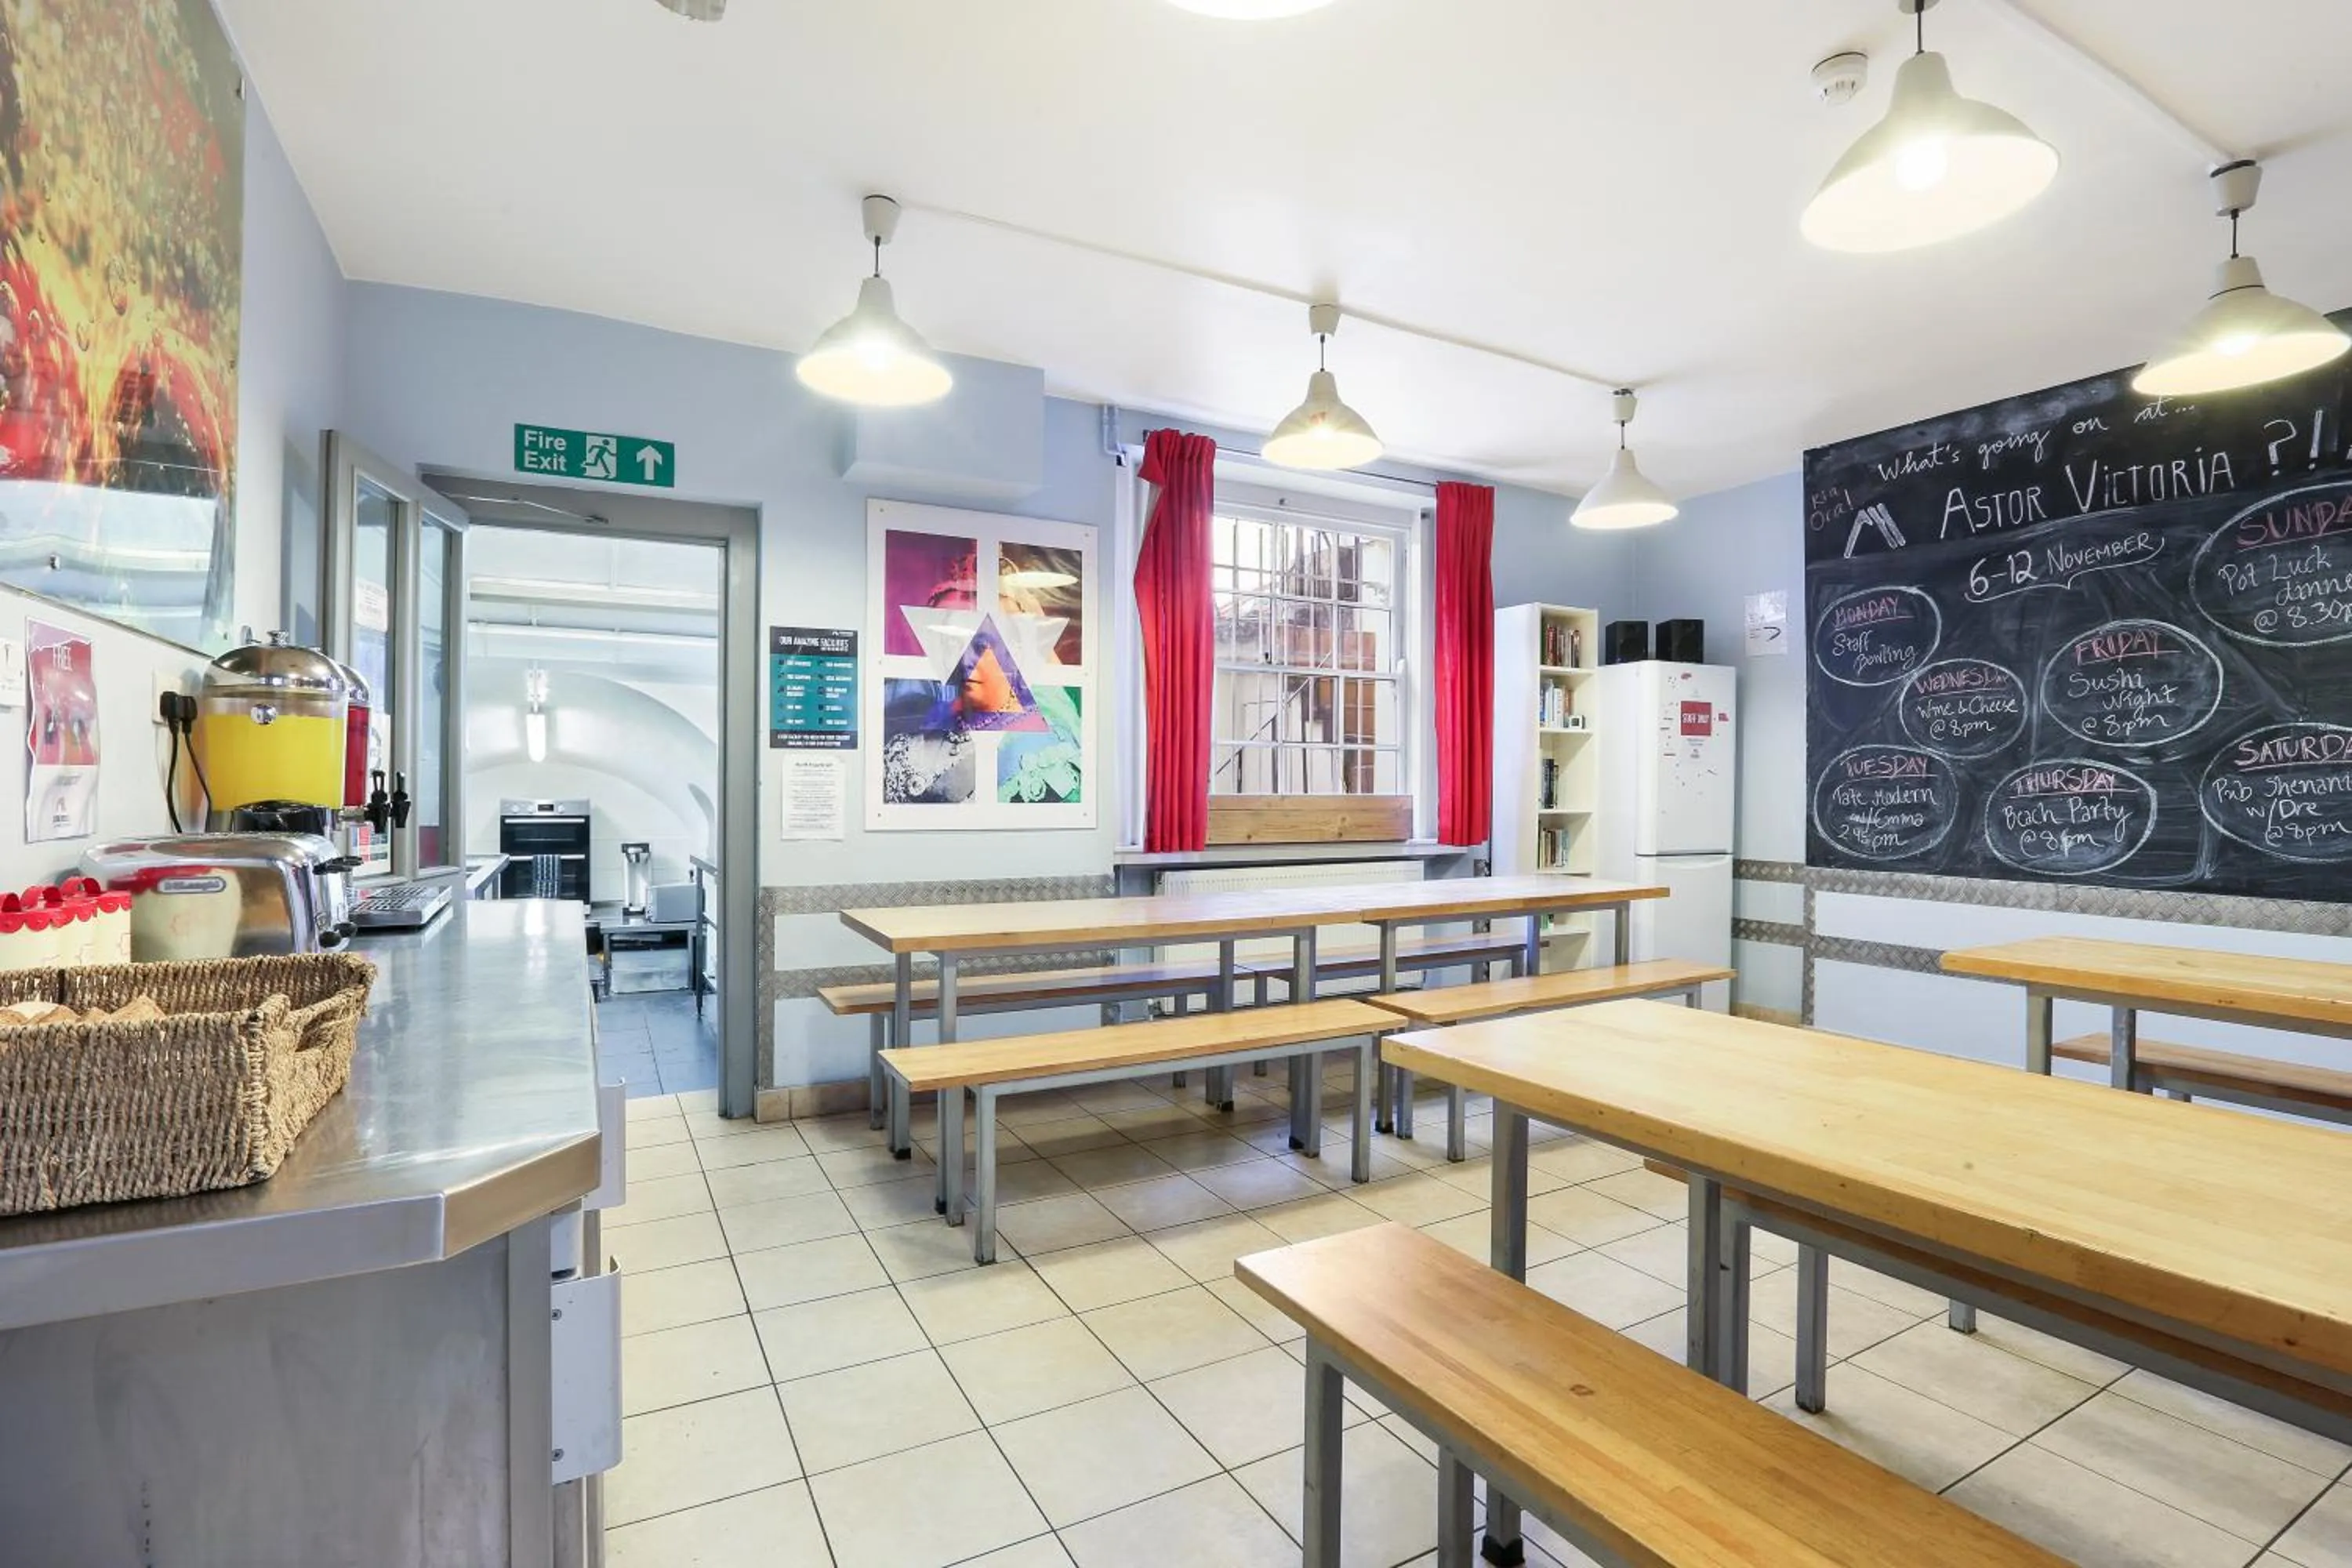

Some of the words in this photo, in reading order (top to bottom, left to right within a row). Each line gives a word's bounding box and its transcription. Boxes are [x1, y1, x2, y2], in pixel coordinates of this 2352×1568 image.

[524, 429, 567, 451] Fire
[1878, 442, 1960, 481] What's
[1978, 430, 2049, 469] going
[2073, 416, 2109, 434] on
[524, 450, 567, 472] Exit
[1939, 487, 2048, 539] ASTOR
[1969, 550, 2038, 596] 6-12
[2046, 532, 2155, 575] NOVEMBER
[2218, 563, 2259, 597] Pot
[2269, 545, 2332, 581] Luck
[1833, 596, 1900, 628] MONDAY
[1832, 630, 1873, 656] Staff
[2075, 628, 2160, 666] FRIDAY
[2067, 667, 2145, 698] Sushi
[1950, 719, 1995, 738] 8pm
[2103, 714, 2171, 737] 8pm
[1840, 753, 1929, 780] TUESDAY
[2008, 768, 2116, 797] THURSDAY
[2212, 776, 2252, 803] Pub
[2003, 802, 2062, 831] Beach
[2067, 796, 2133, 843] Party
